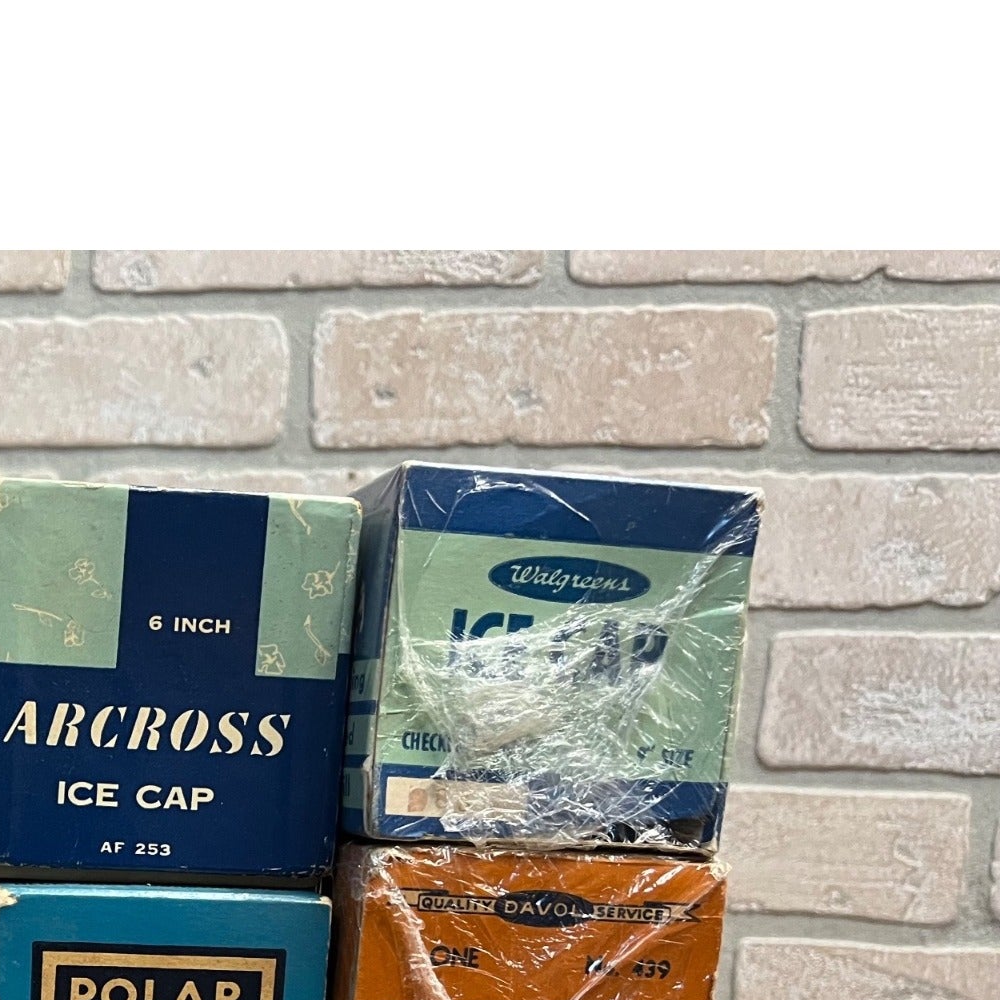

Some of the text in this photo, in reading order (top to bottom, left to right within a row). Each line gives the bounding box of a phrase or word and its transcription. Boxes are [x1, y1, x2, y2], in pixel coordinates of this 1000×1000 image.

[511, 564, 631, 592] Walgreens
[149, 616, 231, 634] 6 INCH
[3, 700, 291, 757] ARCROSS
[57, 781, 215, 811] ICE CAP
[101, 841, 171, 856] AF 253
[420, 896, 665, 921] QUALITY DAVOL SERVICE
[430, 946, 670, 979] ONE 439
